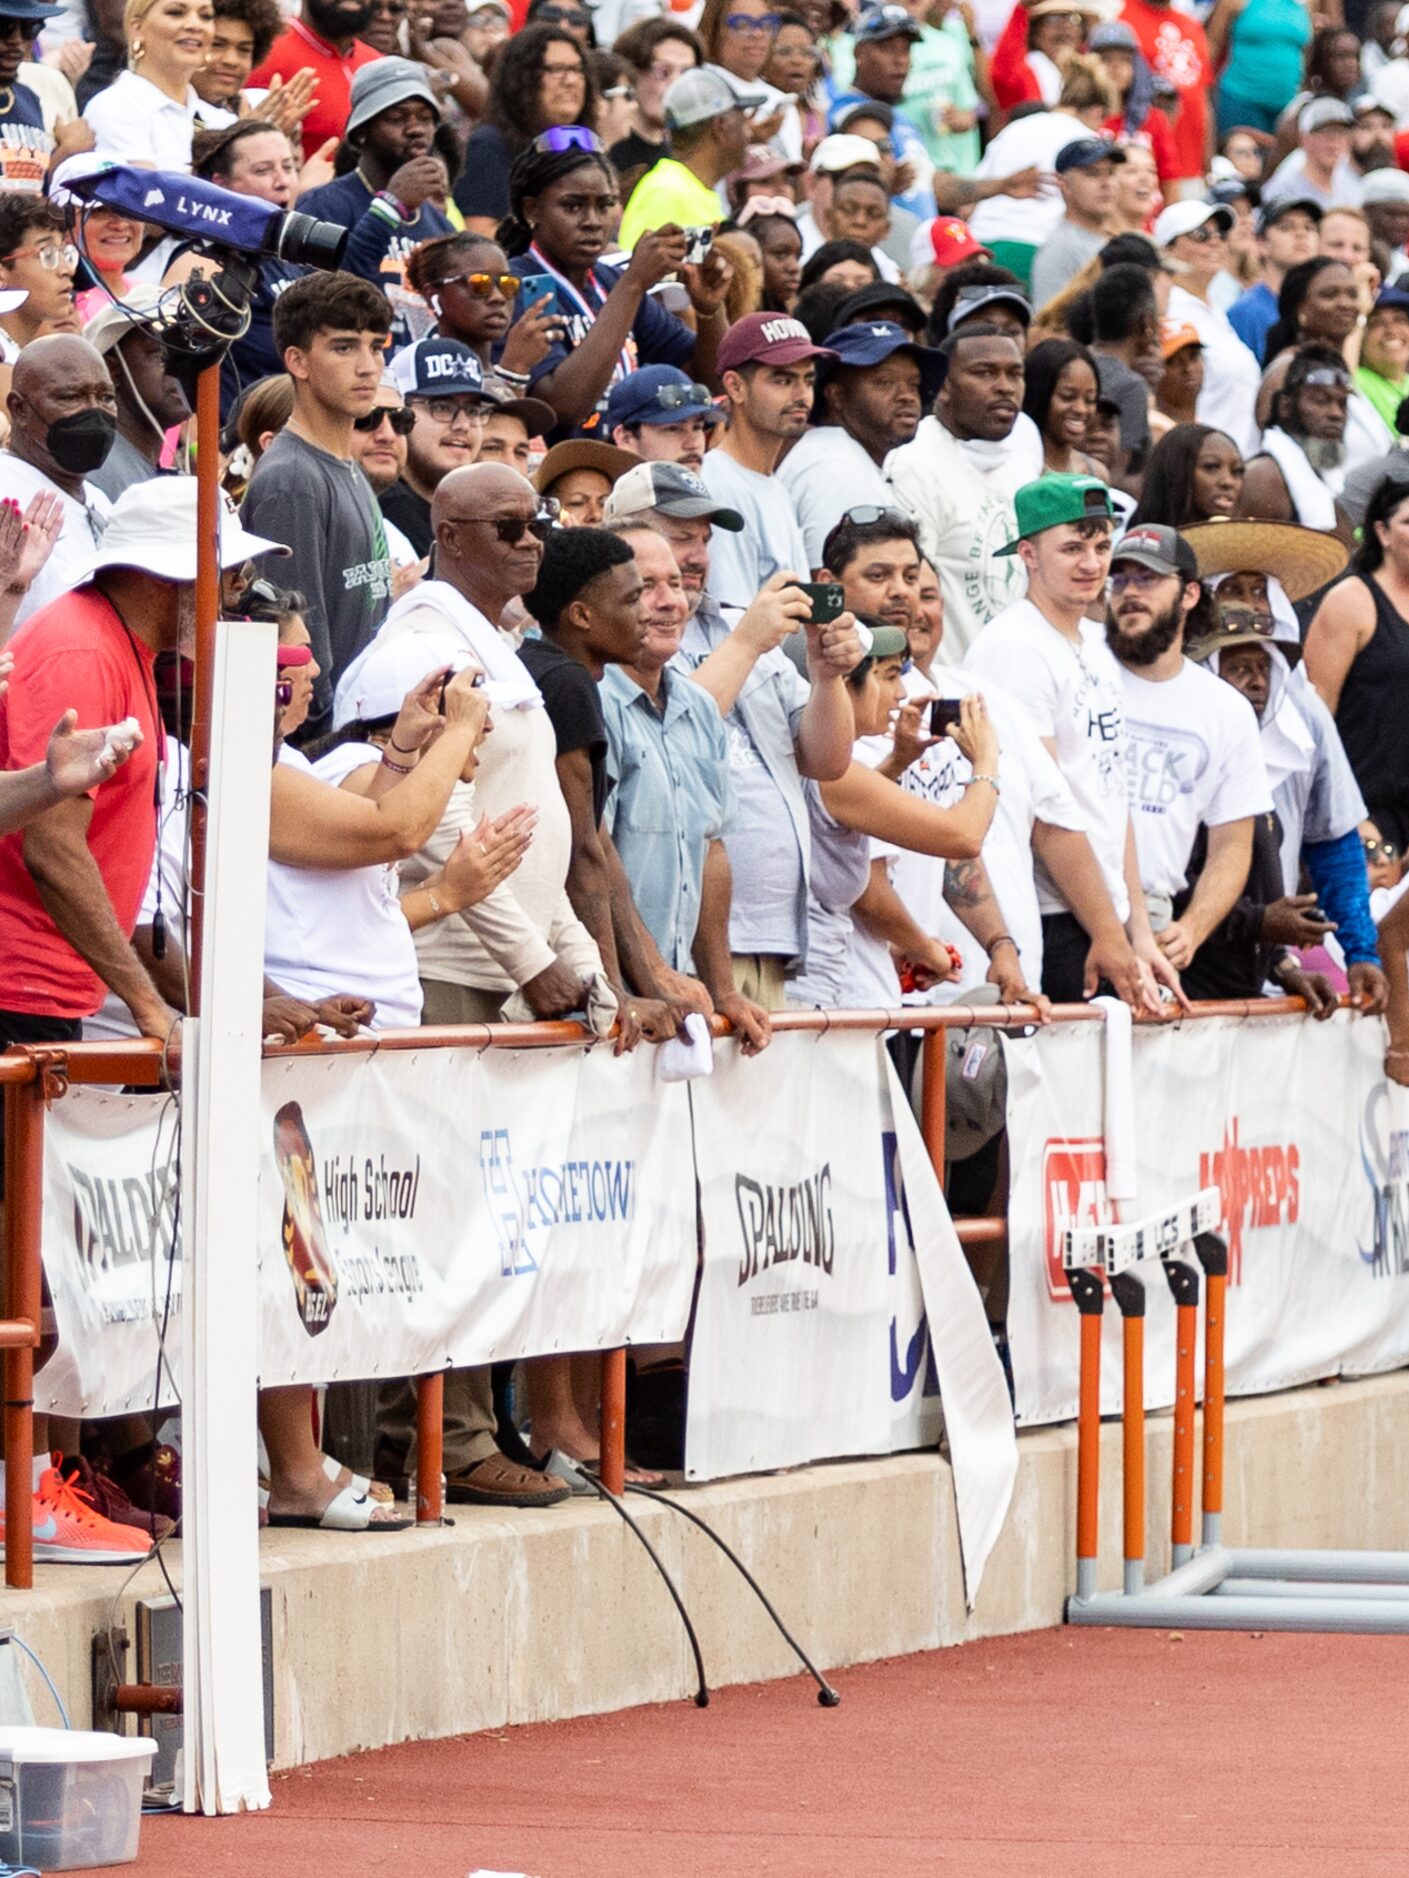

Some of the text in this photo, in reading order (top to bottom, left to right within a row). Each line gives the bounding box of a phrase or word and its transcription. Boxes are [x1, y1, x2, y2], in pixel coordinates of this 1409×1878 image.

[177, 196, 233, 226] LYNX
[324, 1155, 358, 1235] High
[364, 1153, 421, 1221] School
[735, 1163, 834, 1288] SPALDING
